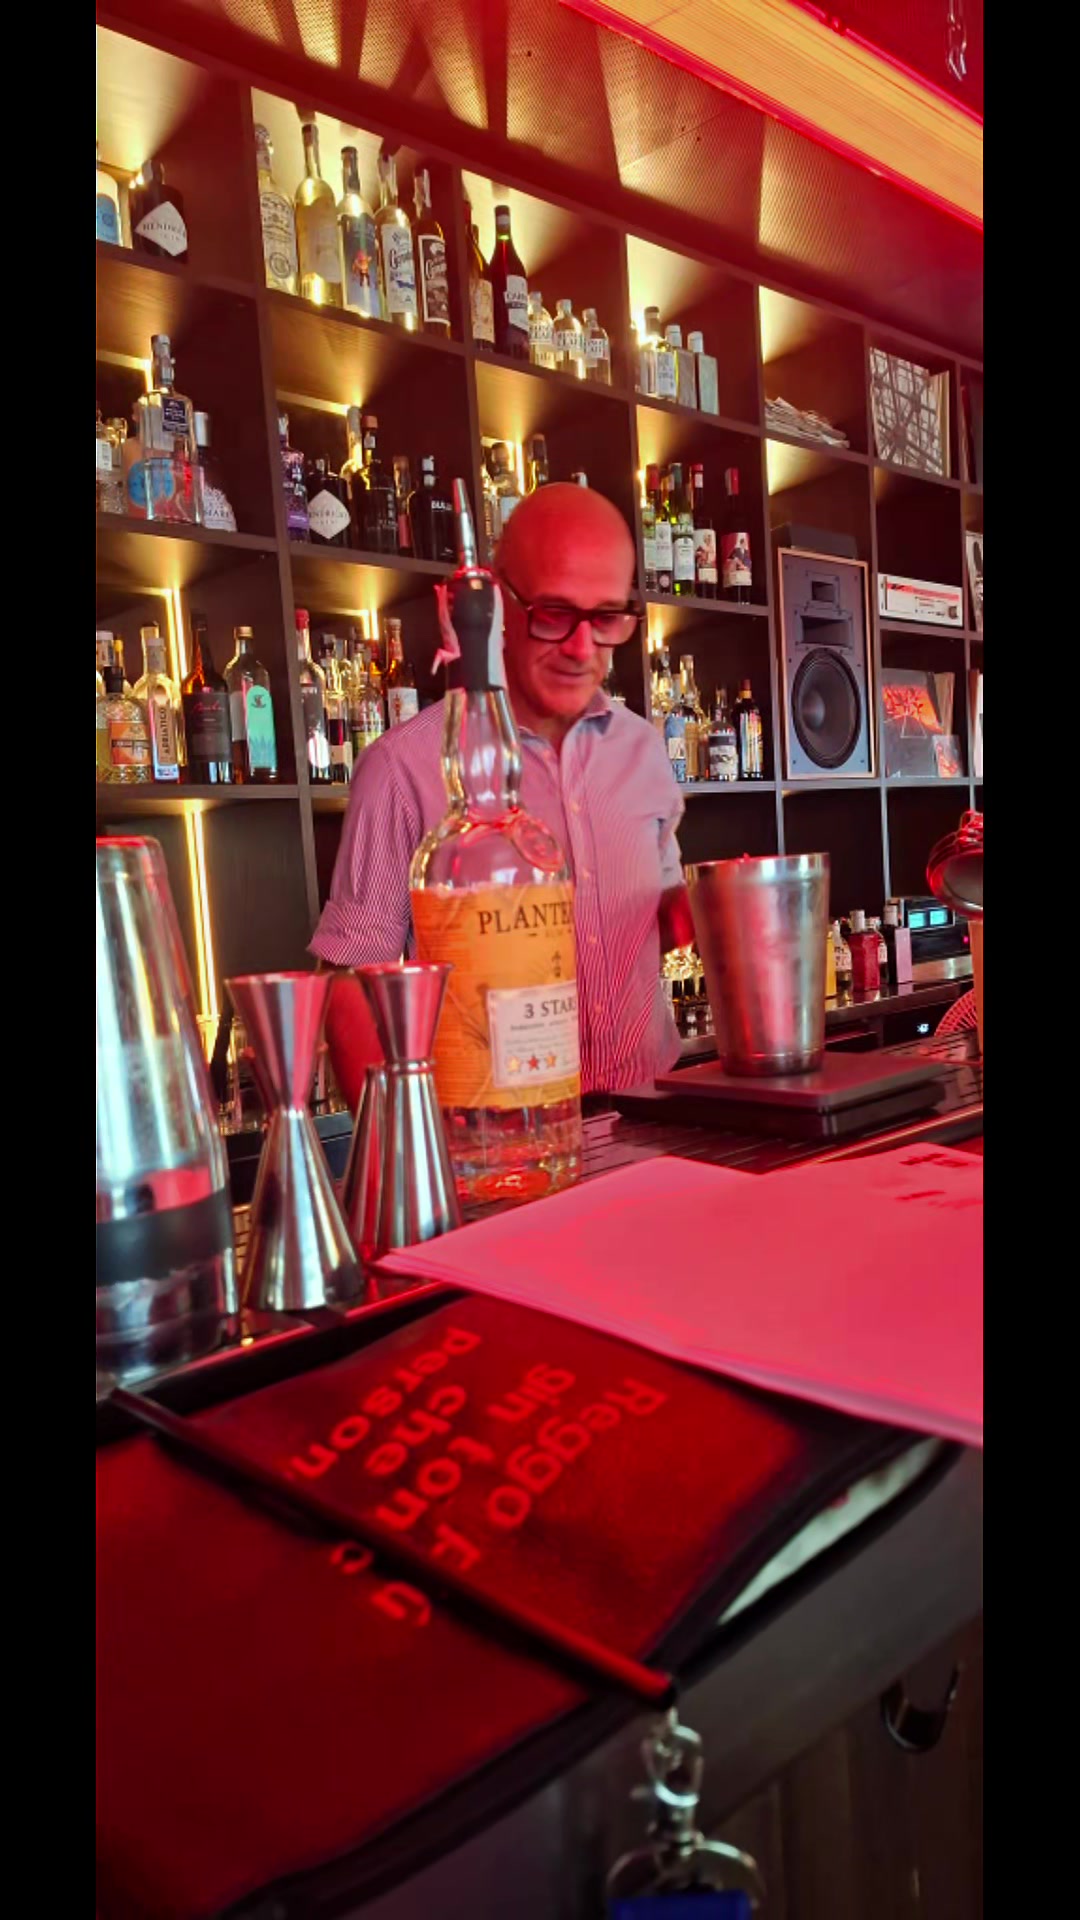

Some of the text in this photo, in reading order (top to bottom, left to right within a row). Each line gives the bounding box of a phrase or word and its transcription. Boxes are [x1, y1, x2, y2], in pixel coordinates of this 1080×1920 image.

[524, 1003, 536, 1019] 3
[289, 1326, 483, 1480] person
[330, 1362, 577, 1574] gin tonc
[364, 1384, 467, 1477] che
[487, 1377, 668, 1528] Reggo
